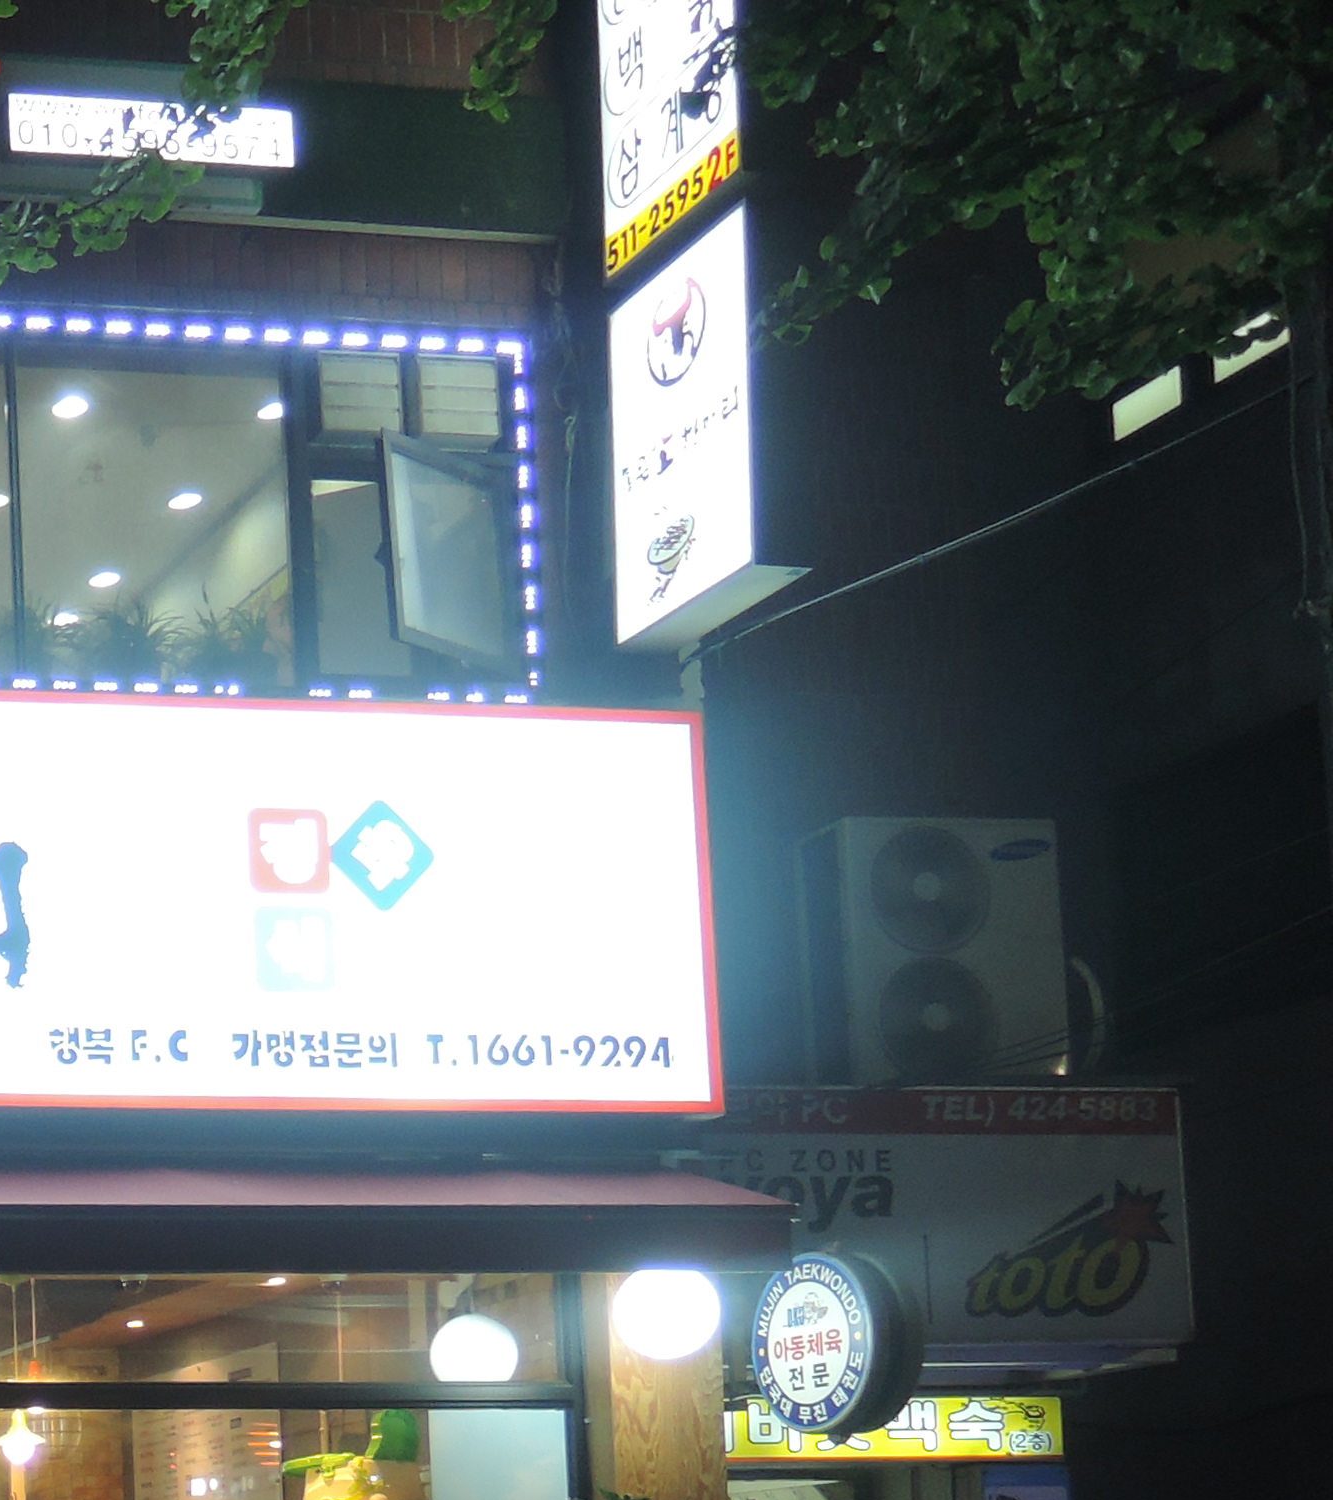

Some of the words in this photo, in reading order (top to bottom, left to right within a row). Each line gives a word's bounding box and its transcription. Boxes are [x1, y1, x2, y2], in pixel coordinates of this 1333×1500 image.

[231, 1030, 399, 1069] 가맹점문의
[789, 1149, 893, 1173] ZONE
[757, 1281, 785, 1338] MUJIN
[784, 1263, 862, 1326] TAEKWONDO
[773, 1328, 843, 1363] 아동체육
[798, 1404, 829, 1425] 무진
